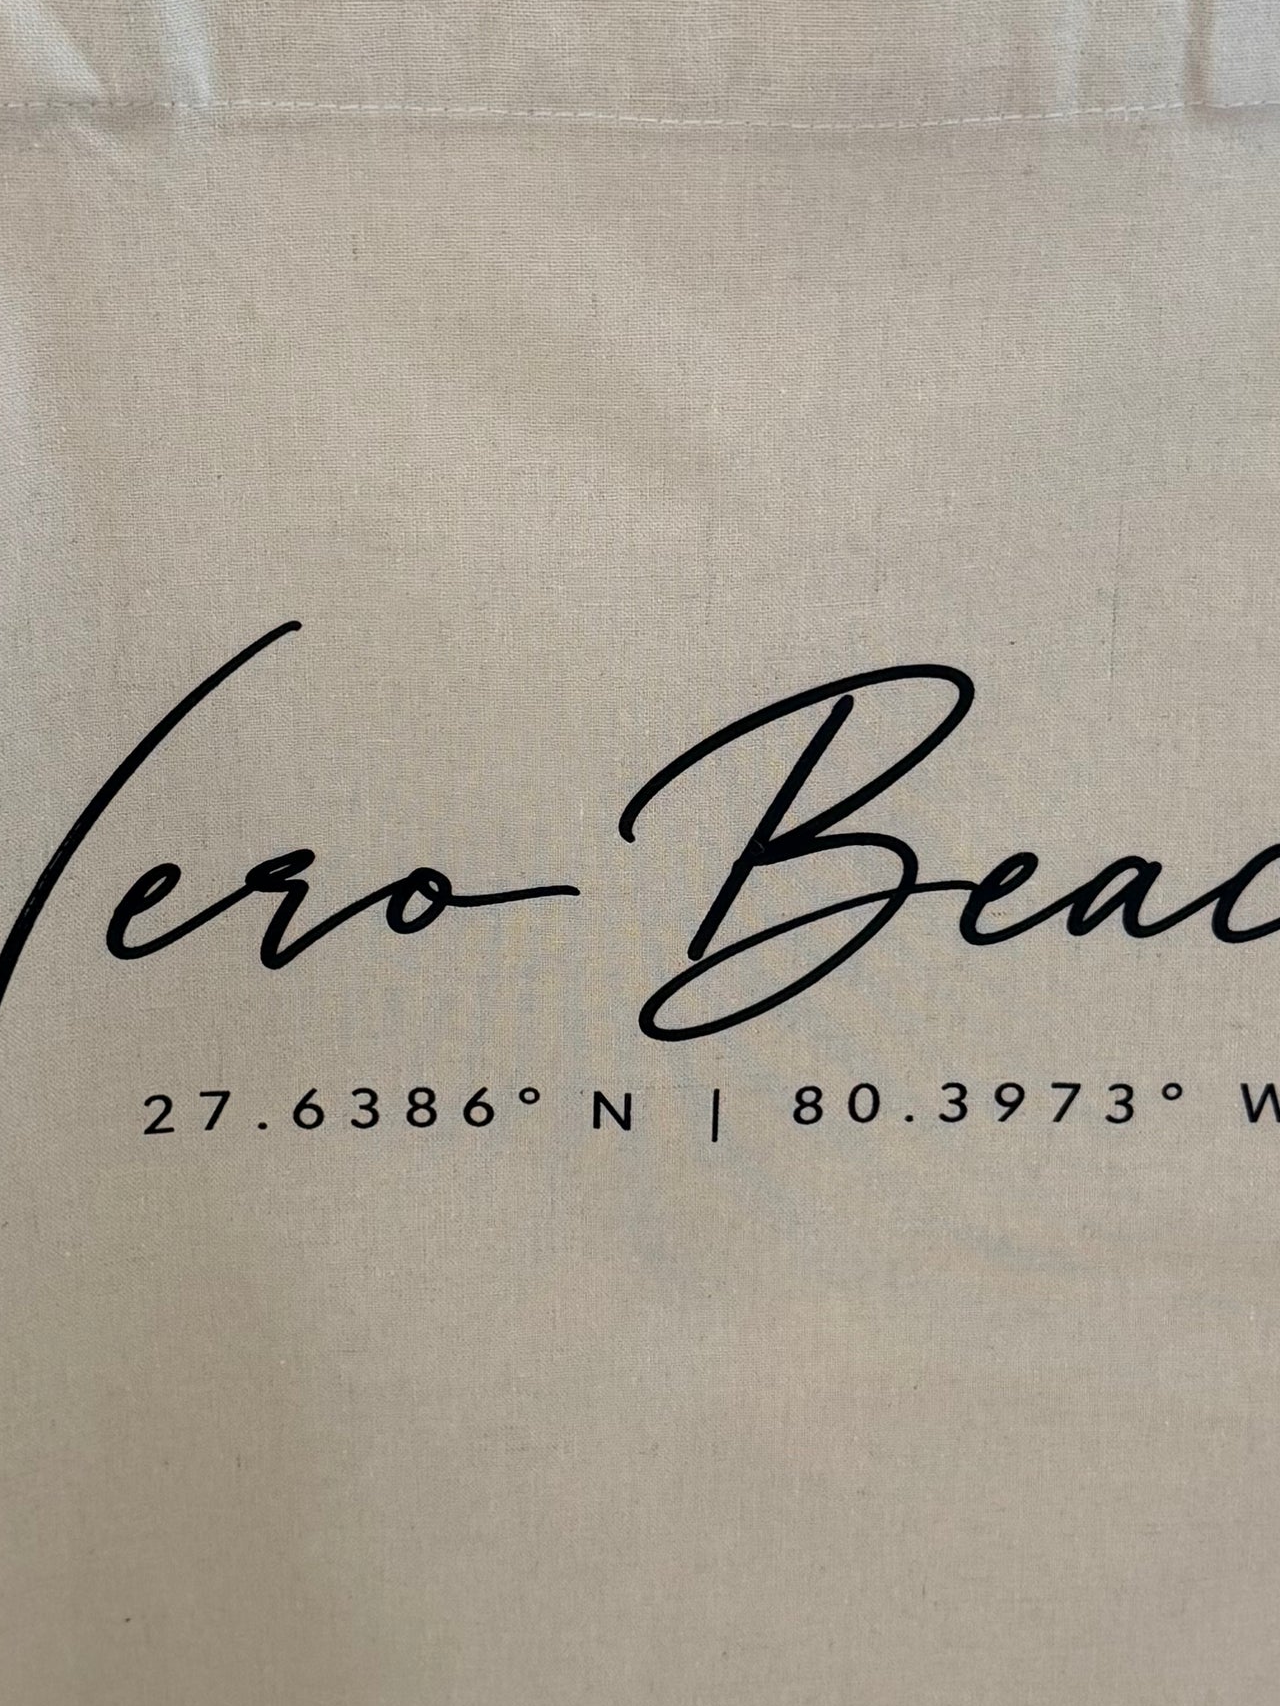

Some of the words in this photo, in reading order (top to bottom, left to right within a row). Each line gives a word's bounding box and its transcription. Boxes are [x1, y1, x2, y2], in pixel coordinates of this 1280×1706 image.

[143, 1086, 542, 1136] 27.6386°
[592, 1090, 632, 1132] N
[791, 1081, 1184, 1126] 80.3973°
